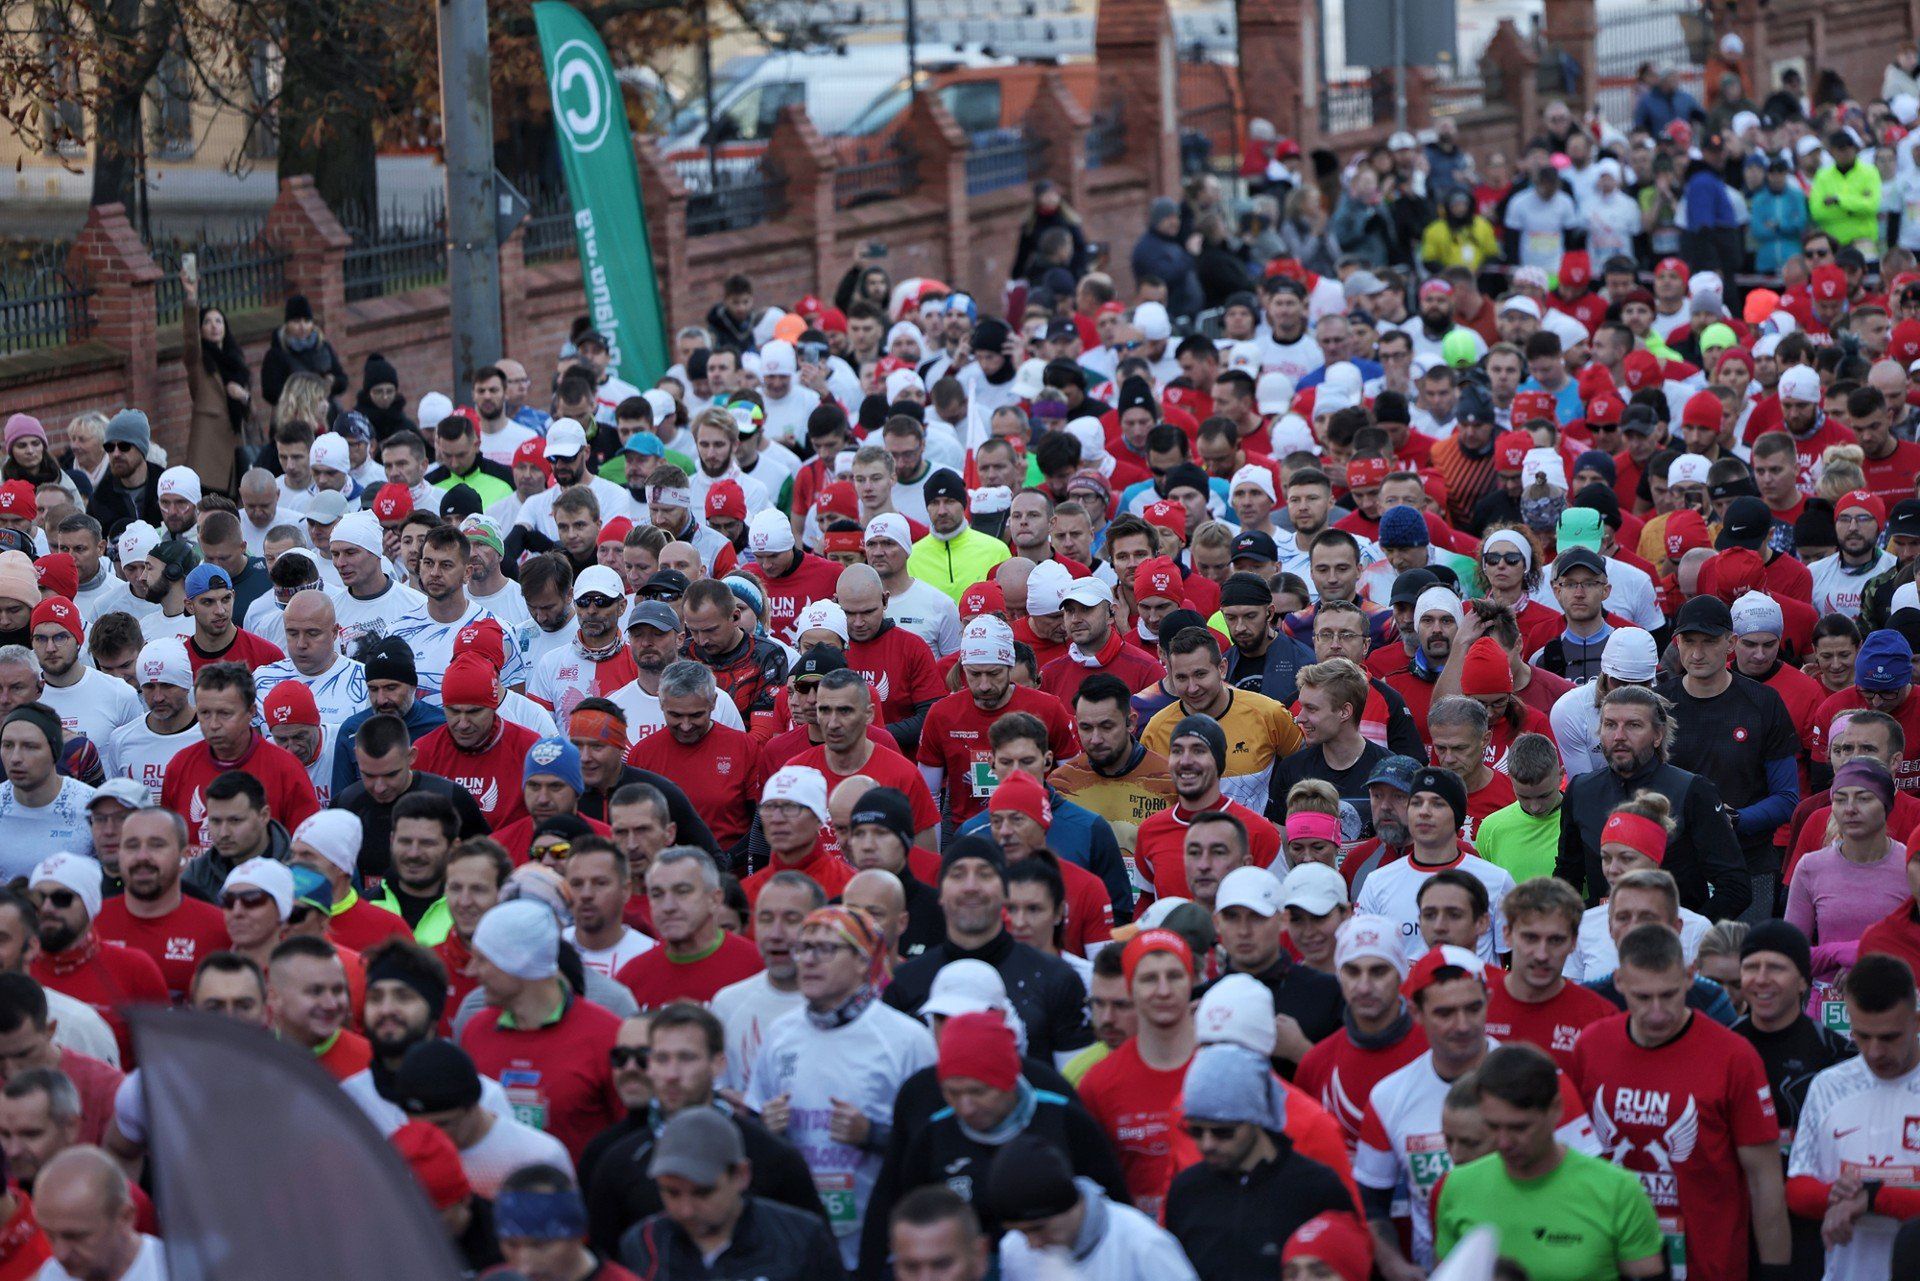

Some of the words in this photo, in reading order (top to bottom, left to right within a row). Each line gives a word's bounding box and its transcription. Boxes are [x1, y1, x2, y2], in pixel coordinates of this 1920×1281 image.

[767, 596, 795, 610] UN
[770, 609, 795, 618] LAND
[1137, 796, 1167, 811] TORO
[1132, 807, 1144, 819] DE
[1614, 1087, 1671, 1116] RUN
[1613, 1109, 1668, 1127] POLAND
